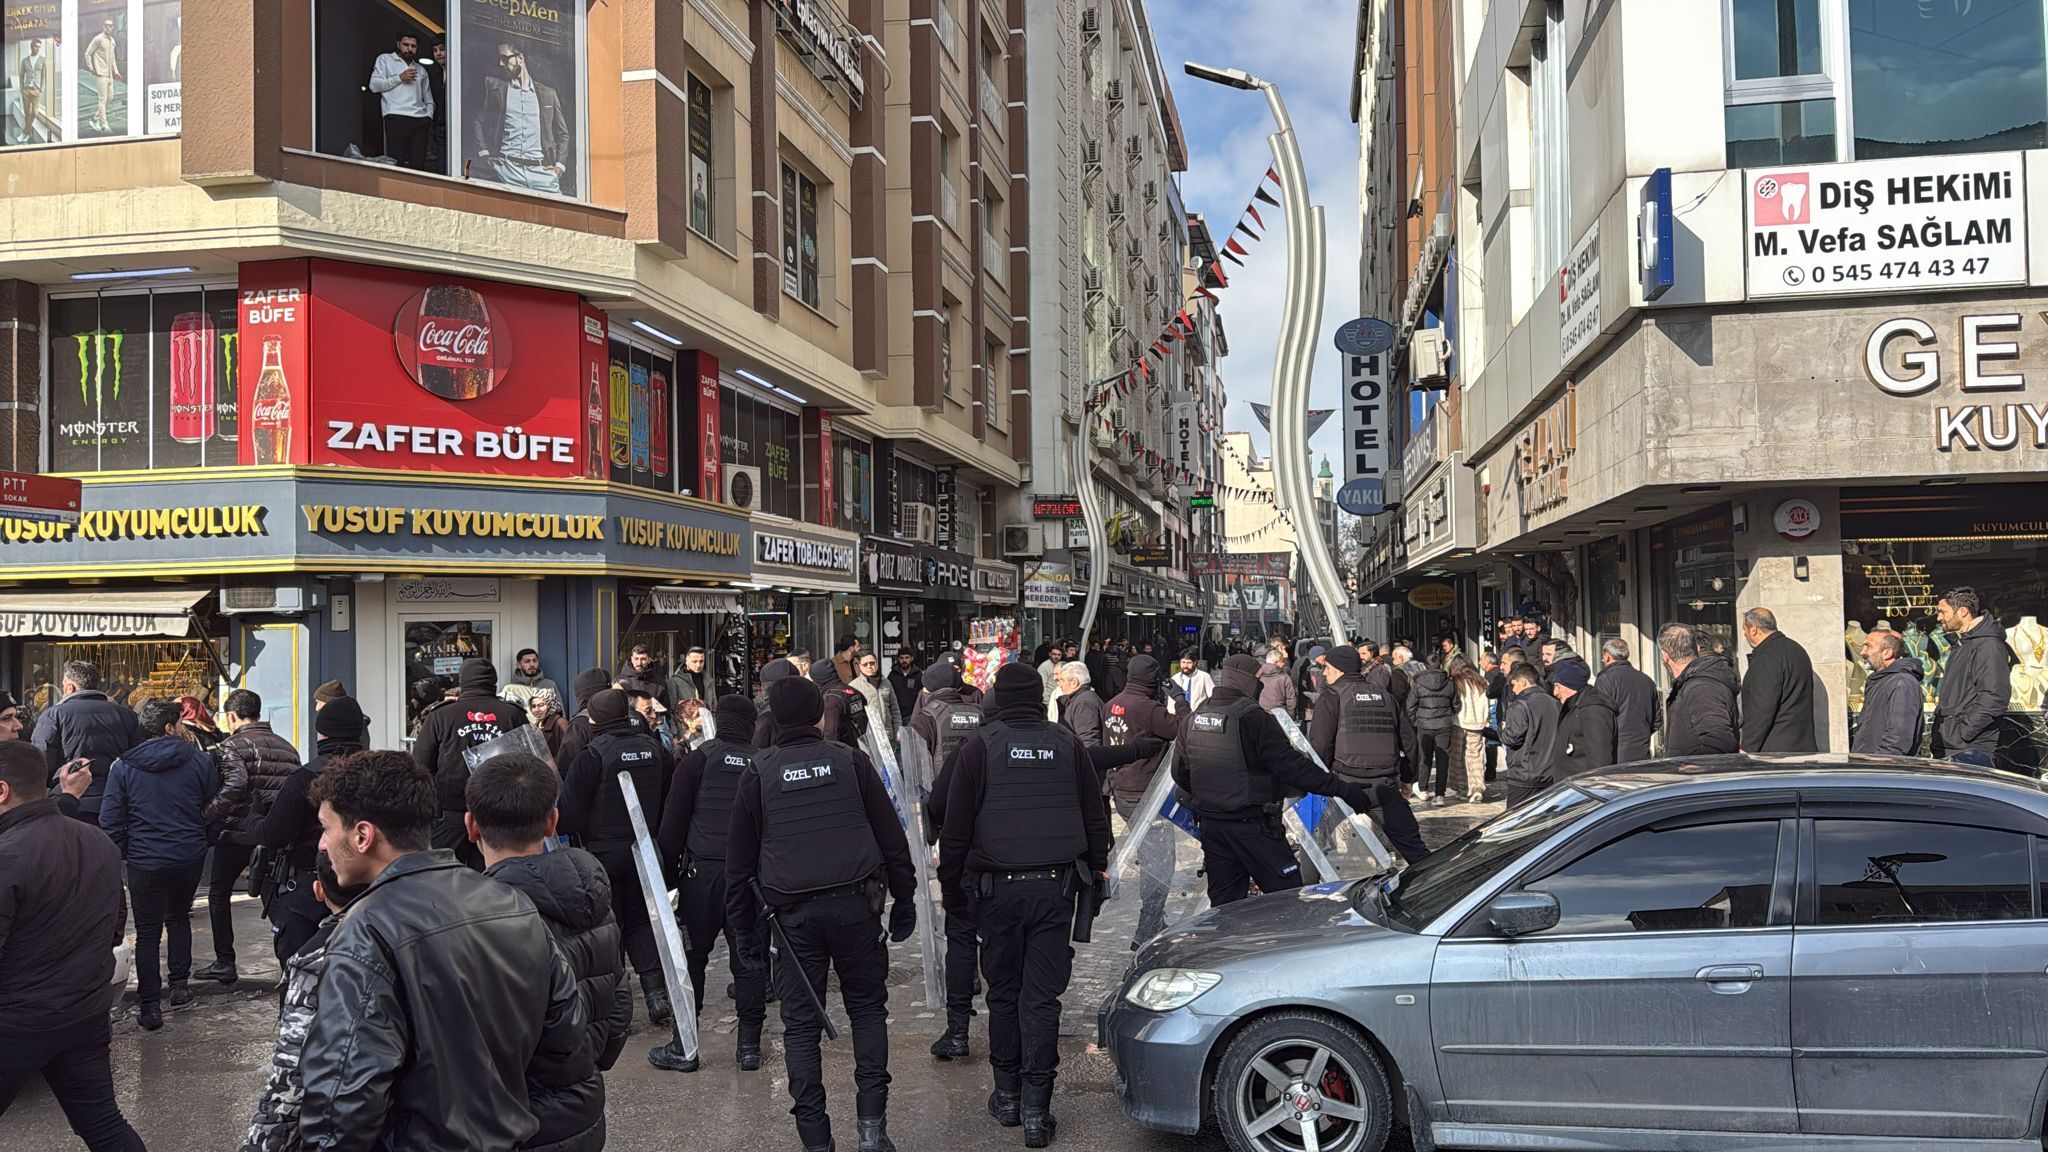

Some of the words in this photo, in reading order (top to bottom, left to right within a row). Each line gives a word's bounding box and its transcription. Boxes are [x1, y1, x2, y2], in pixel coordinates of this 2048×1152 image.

[151, 89, 181, 100] SOYDA
[1754, 231, 1788, 257] M.
[1798, 227, 1866, 255] Vefa
[1877, 215, 2012, 250] SAĞLAM
[1812, 266, 1825, 283] 0
[1832, 263, 1873, 282] 545
[1880, 260, 1921, 280] 474
[1928, 258, 1956, 277] 43
[1962, 256, 1990, 275] 47
[244, 288, 300, 305] ZAFER
[249, 306, 295, 324] BÜFE
[419, 320, 491, 356] Coca-Cola
[1864, 311, 2048, 398] GE
[1350, 355, 1383, 475] HOTEL
[72, 437, 128, 446] ENERGY
[326, 420, 464, 457] ZAFER
[475, 425, 575, 464] BÜFE
[1179, 417, 1190, 472] HOTEL
[3, 477, 27, 492] PTT
[3, 493, 28, 503] SOKAK
[78, 505, 261, 539] KUYUMCULUK
[302, 504, 405, 534] YUSUF
[412, 508, 605, 541] KUYUMCULUK
[618, 515, 665, 548] YUSUF
[665, 522, 742, 557] KUYUMCULUK
[764, 536, 794, 564] ZAFER
[795, 541, 832, 568] TOBACCO
[656, 594, 681, 609] YUSUF
[32, 614, 157, 633] KUYUMCULUK
[457, 723, 483, 737] ÖZEL
[472, 733, 492, 741] VAN
[621, 751, 640, 762] ÖZEL
[724, 754, 745, 766] ÖZEL
[1010, 747, 1036, 760] ÖZEL
[783, 768, 811, 783] ÖZEL
